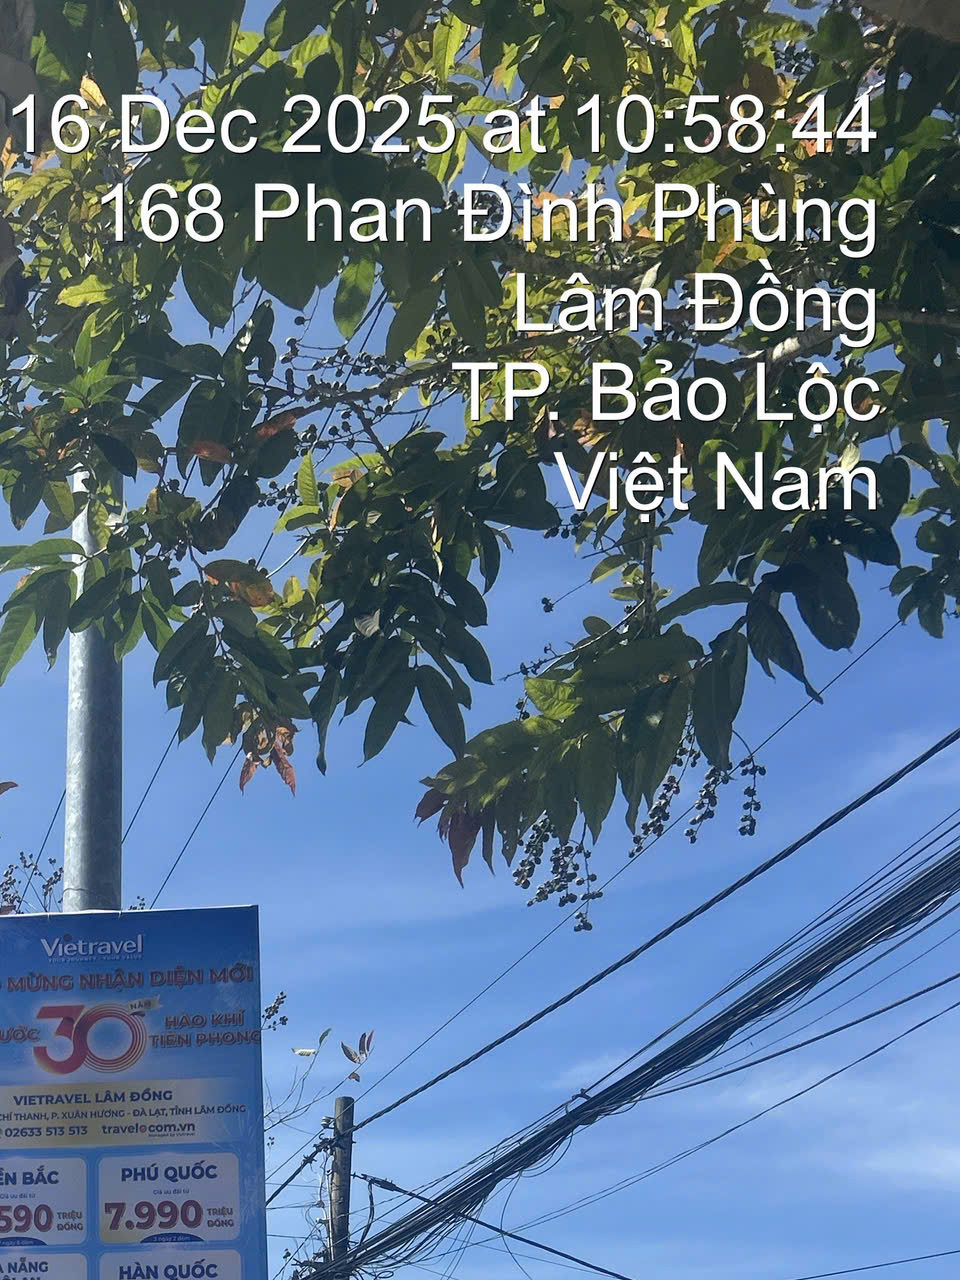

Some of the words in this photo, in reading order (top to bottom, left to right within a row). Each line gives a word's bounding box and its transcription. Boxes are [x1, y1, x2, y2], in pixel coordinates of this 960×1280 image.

[41, 933, 143, 957] Vietravel
[7, 970, 73, 993] MỪNG
[80, 968, 144, 992] NHẬN
[150, 965, 204, 989] DIỆN
[210, 962, 254, 985] MỚI
[165, 1012, 207, 1030] HÀO
[212, 1009, 247, 1027] KHÍ
[33, 1002, 148, 1074] 30
[13, 1093, 91, 1107] VIETRAVEL
[95, 1090, 125, 1104] LÂM
[130, 1087, 173, 1102] ĐỒNG
[14, 1112, 50, 1122] THANH,
[51, 1111, 60, 1120] P.
[62, 1108, 88, 1120] XUÂN
[90, 1108, 125, 1119] HƯƠNG
[132, 1106, 147, 1117] ĐÀ
[148, 1107, 168, 1119] LẠT,
[194, 1104, 215, 1115] LÂM
[4, 1126, 42, 1137] 02633
[46, 1126, 65, 1136] 513
[68, 1125, 88, 1136] 513
[22, 1165, 59, 1185] BẮC
[121, 1163, 159, 1182] PHÚ
[164, 1160, 218, 1183] QUỐC
[104, 1200, 204, 1231] 7.990
[119, 1262, 158, 1280] HÀN
[164, 1258, 218, 1280] QUỐC
